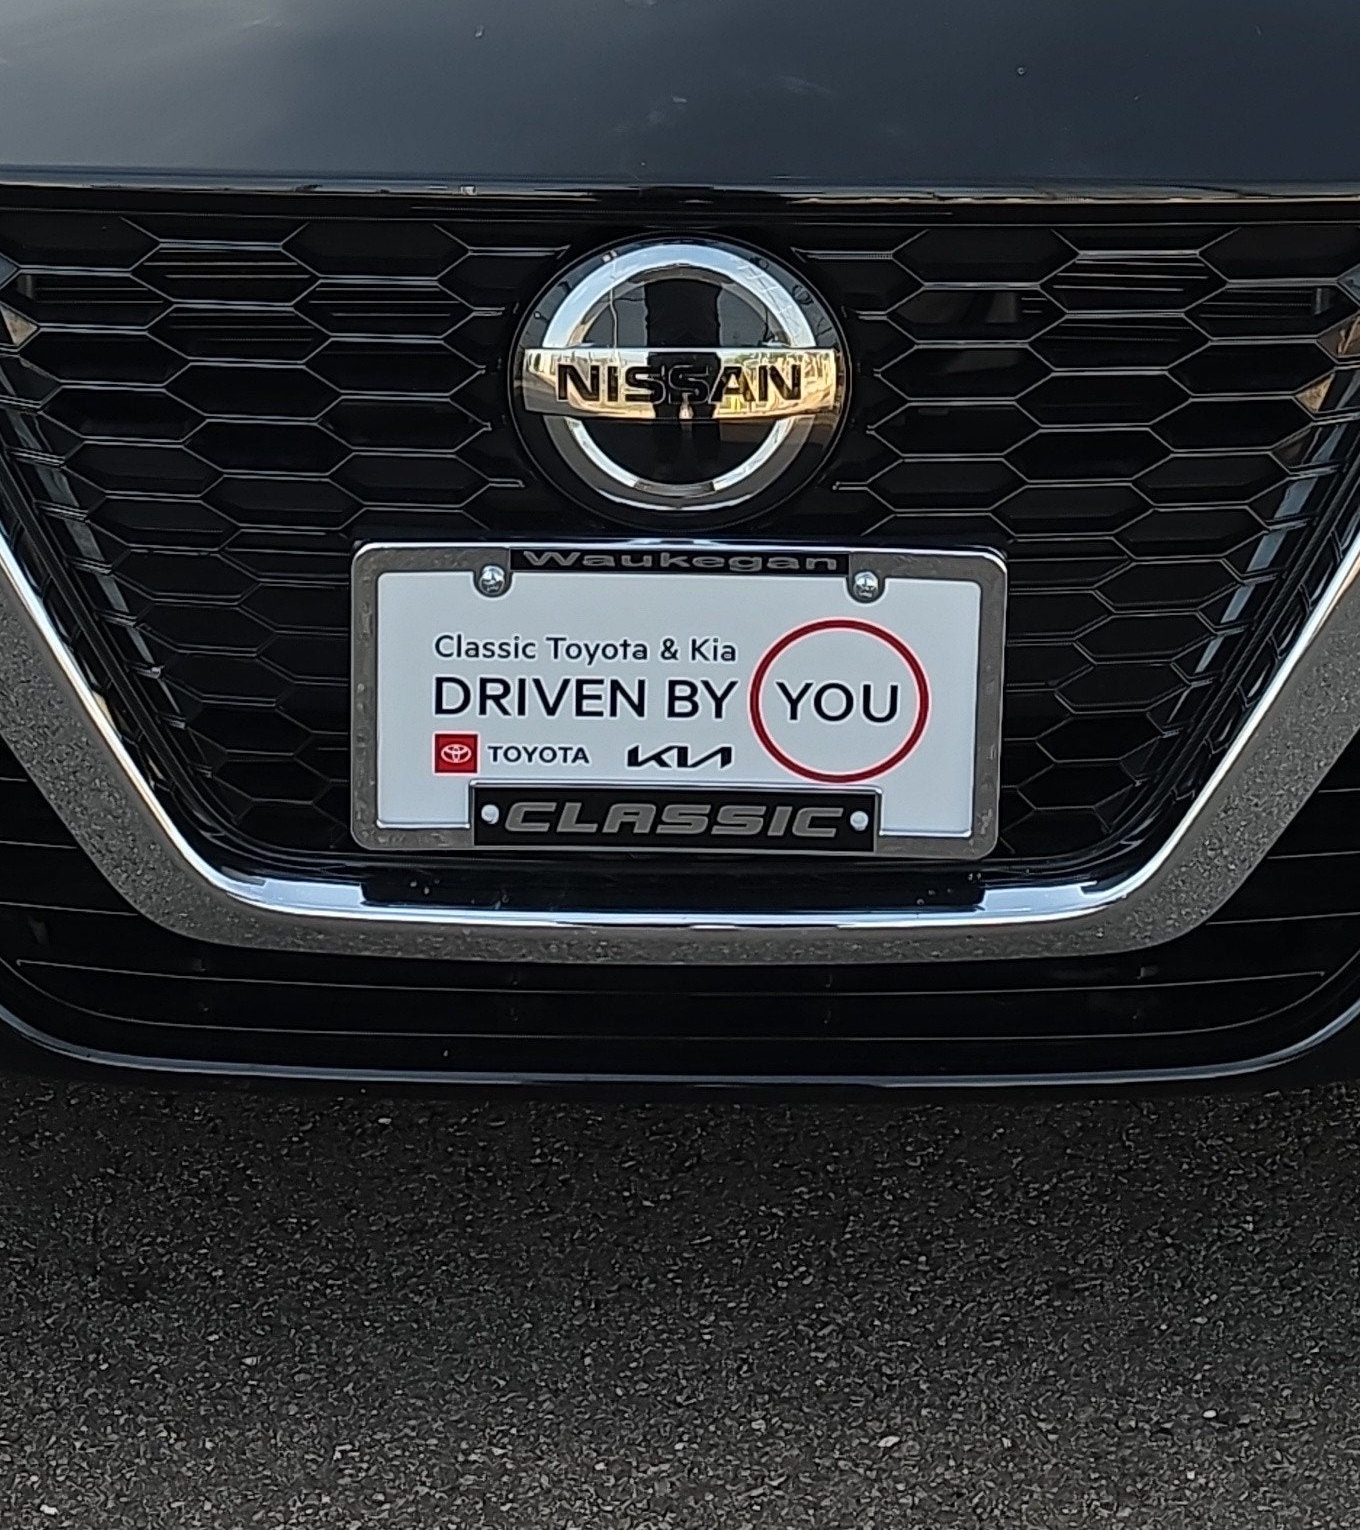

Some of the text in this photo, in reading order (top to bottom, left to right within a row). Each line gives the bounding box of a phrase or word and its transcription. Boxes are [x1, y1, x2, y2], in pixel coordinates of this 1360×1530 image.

[557, 364, 802, 403] NISSAN
[523, 550, 837, 571] Waukegan
[434, 634, 736, 665] Classic Toyota & Kia
[434, 677, 898, 723] DRIVEN BY YOU
[488, 745, 589, 764] TOYOTA
[503, 801, 844, 838] CLASSIC
